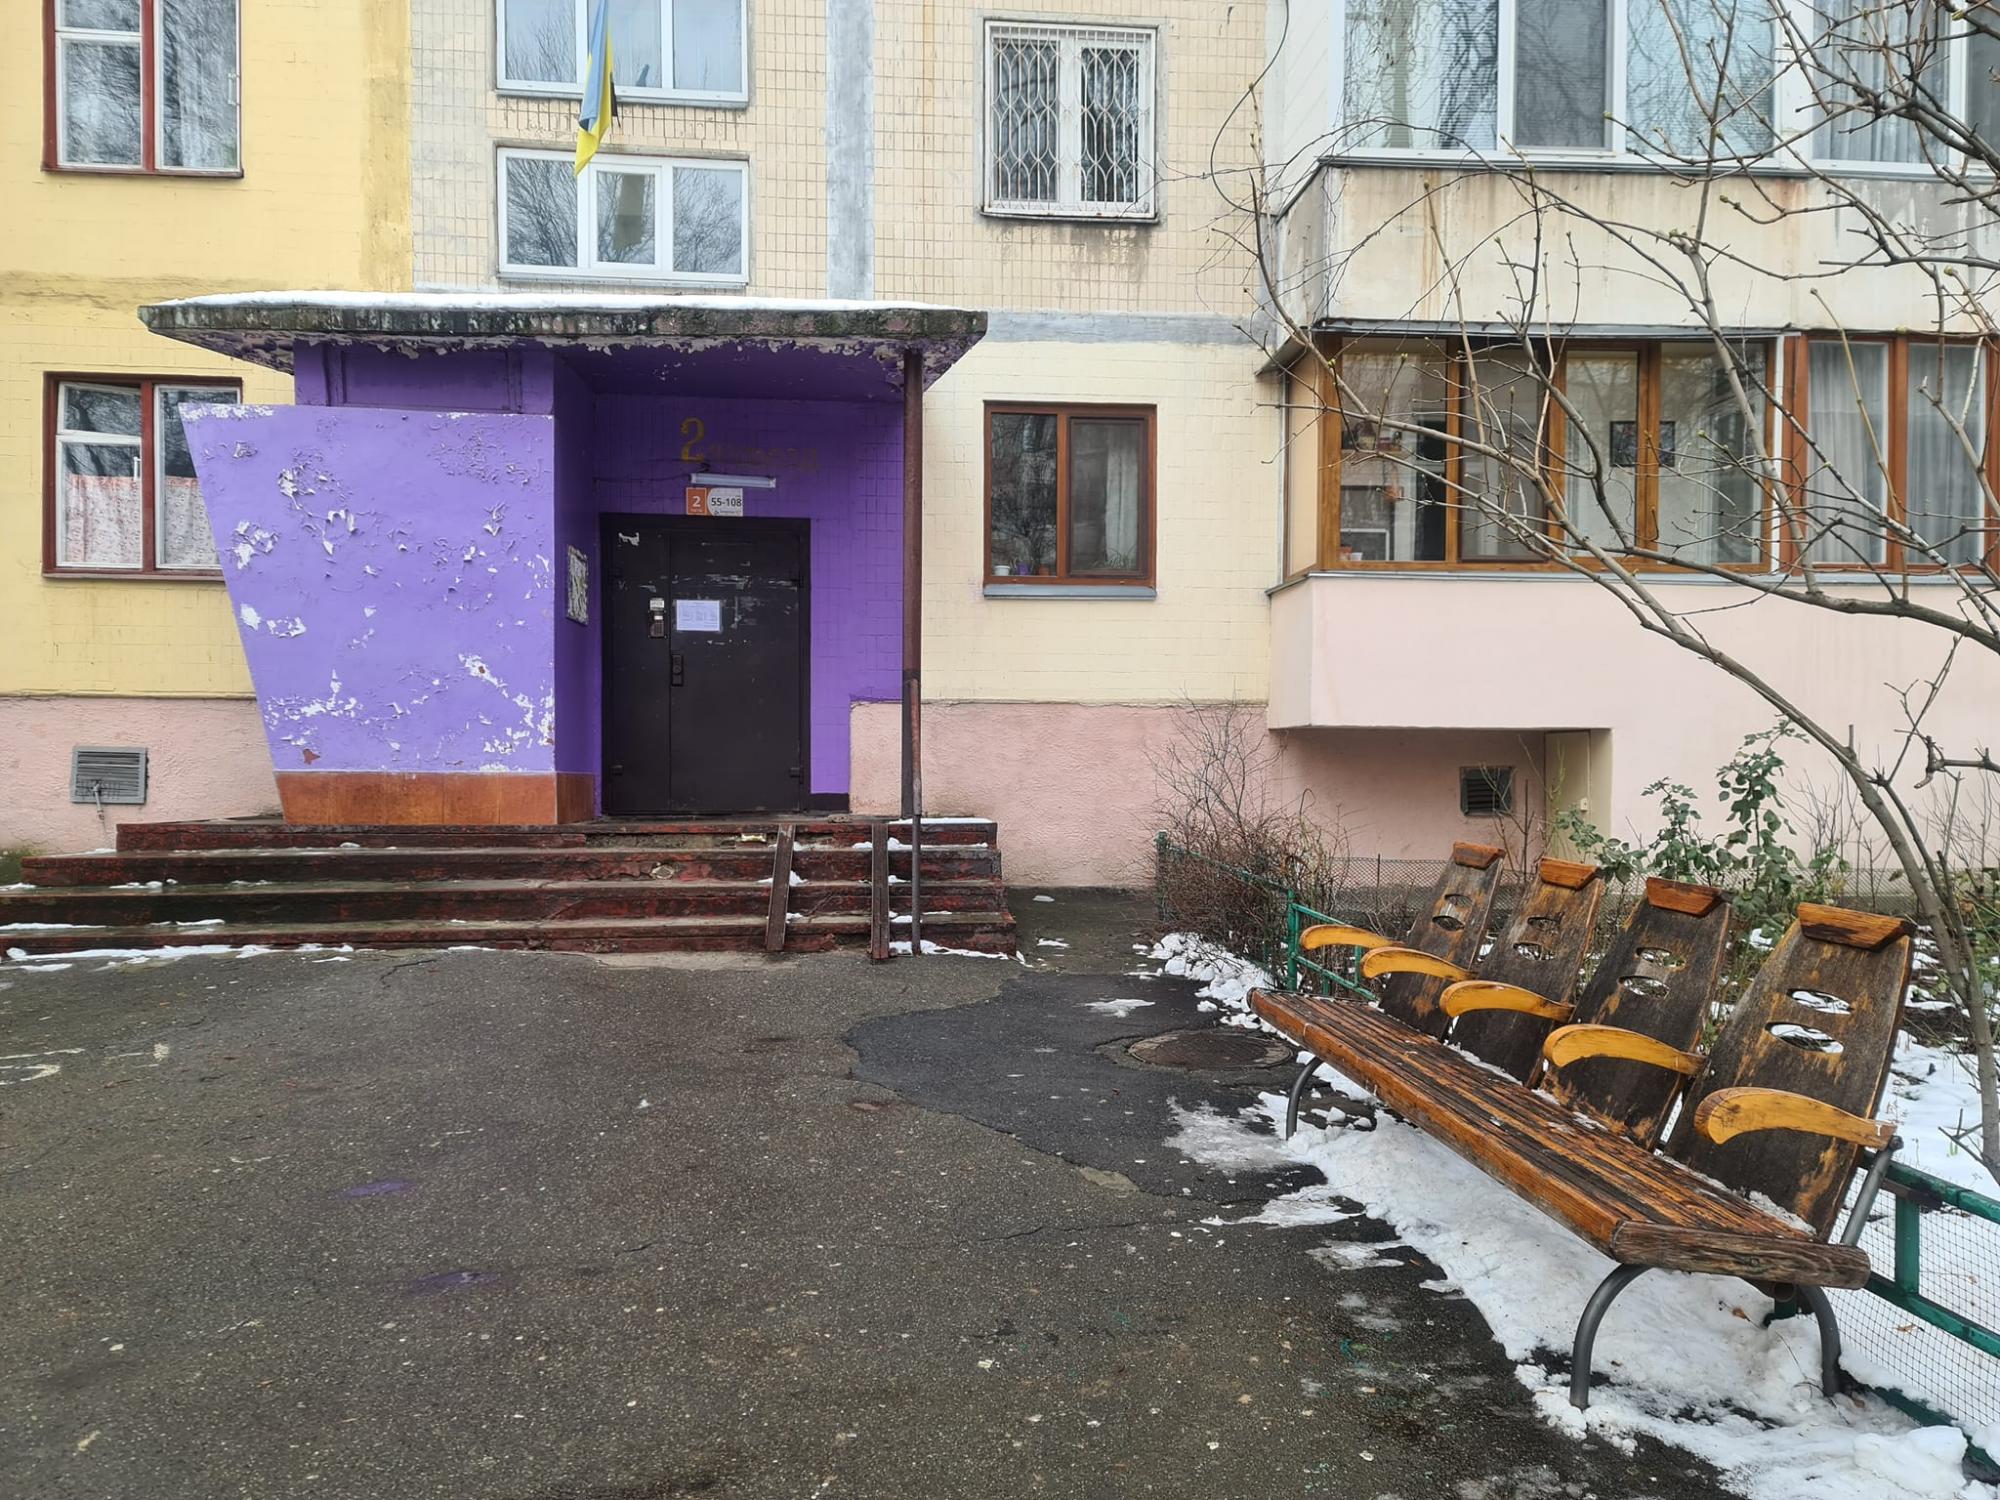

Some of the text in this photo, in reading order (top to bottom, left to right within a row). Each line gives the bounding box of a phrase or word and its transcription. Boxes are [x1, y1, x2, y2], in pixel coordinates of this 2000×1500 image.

[680, 416, 705, 463] 2
[692, 495, 701, 507] 2
[711, 497, 742, 507] 55-108
